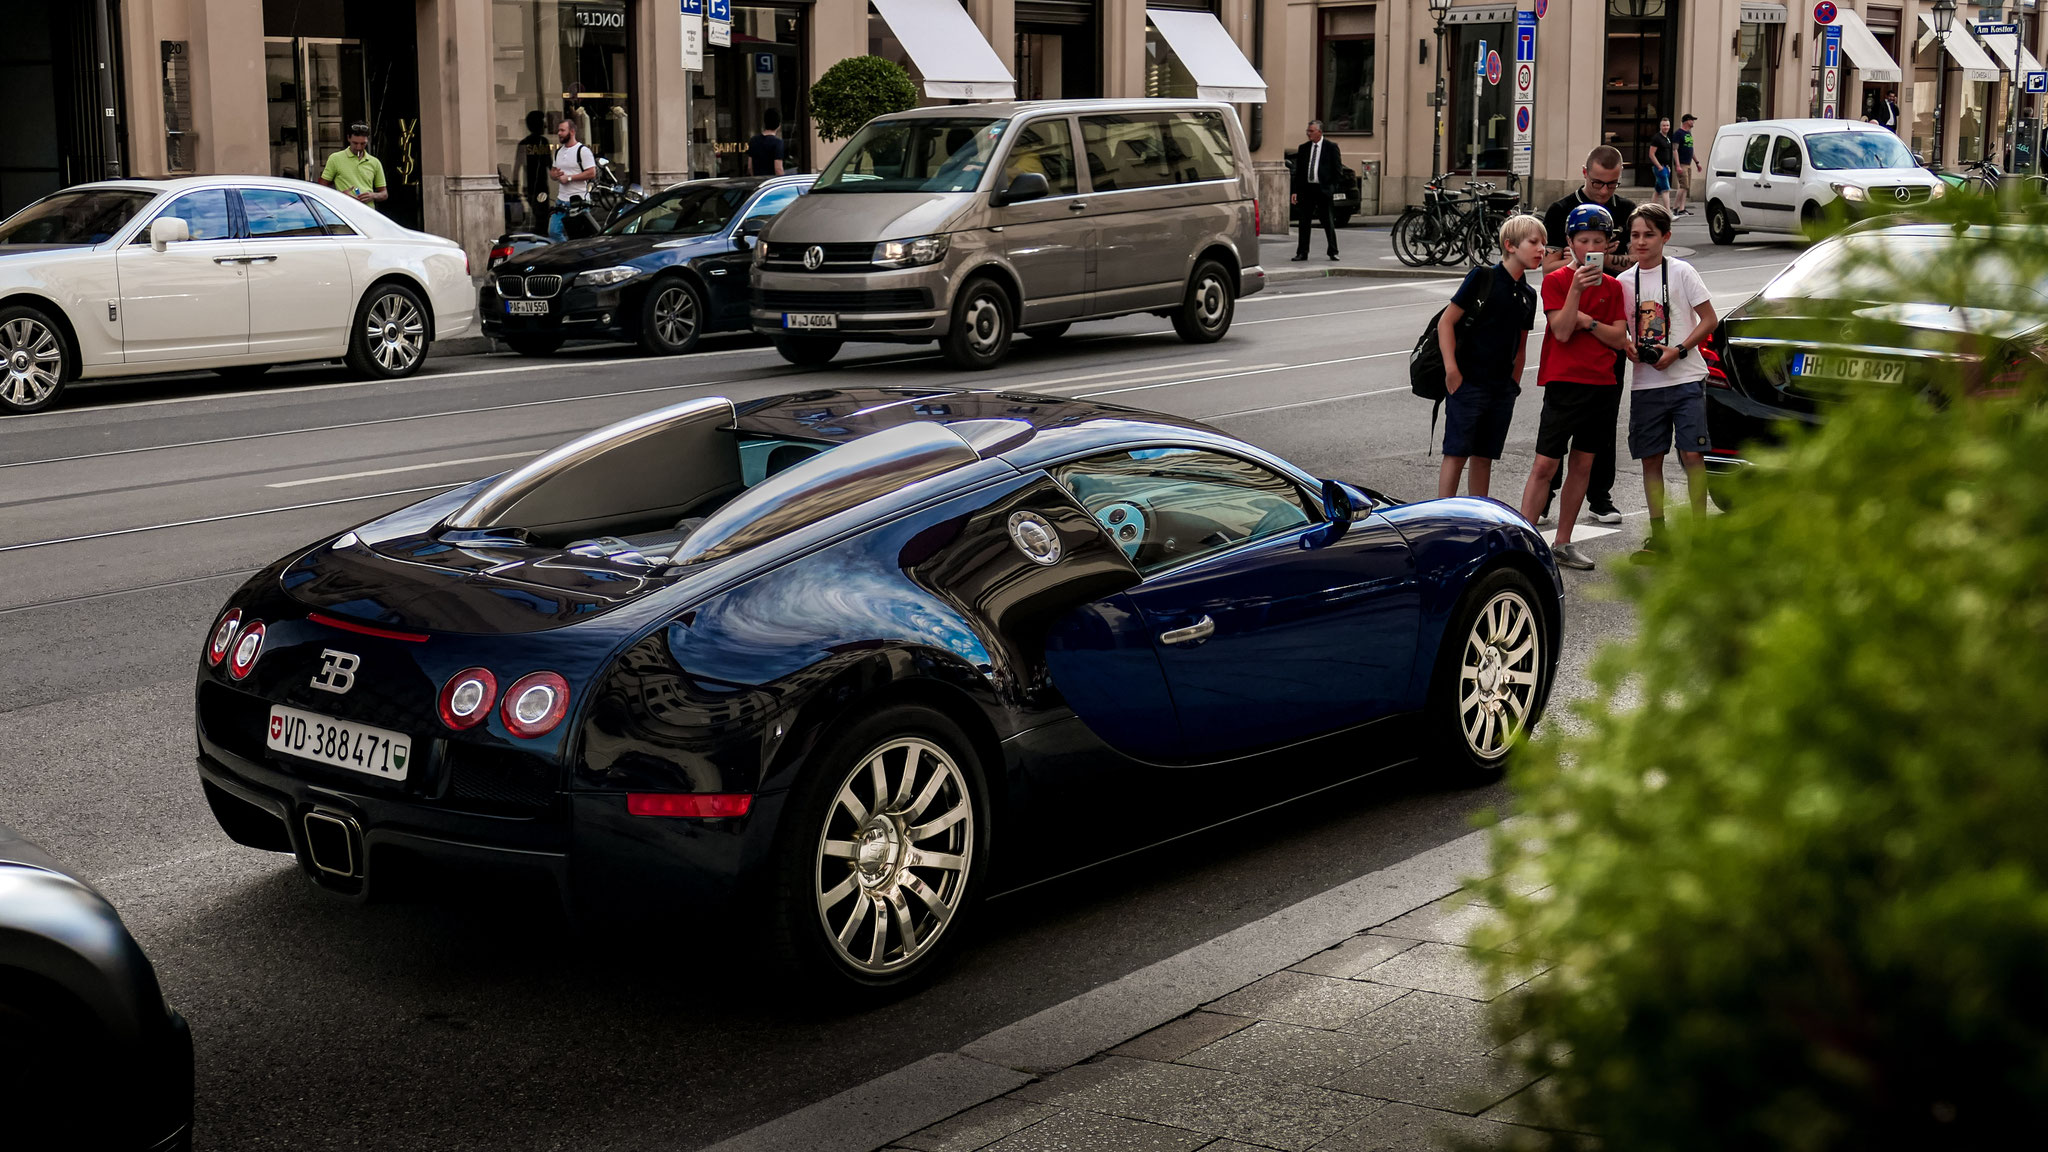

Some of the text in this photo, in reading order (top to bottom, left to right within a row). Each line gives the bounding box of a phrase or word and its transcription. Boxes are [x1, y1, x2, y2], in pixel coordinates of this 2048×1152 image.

[1448, 11, 1507, 21] MARNI
[168, 42, 182, 55] 20
[1520, 71, 1529, 84] 30
[1518, 92, 1529, 100] ZONE
[713, 142, 737, 154] SAINT
[534, 301, 548, 312] 550
[810, 315, 833, 327] 4004
[1802, 356, 1905, 381] HH OC 8497
